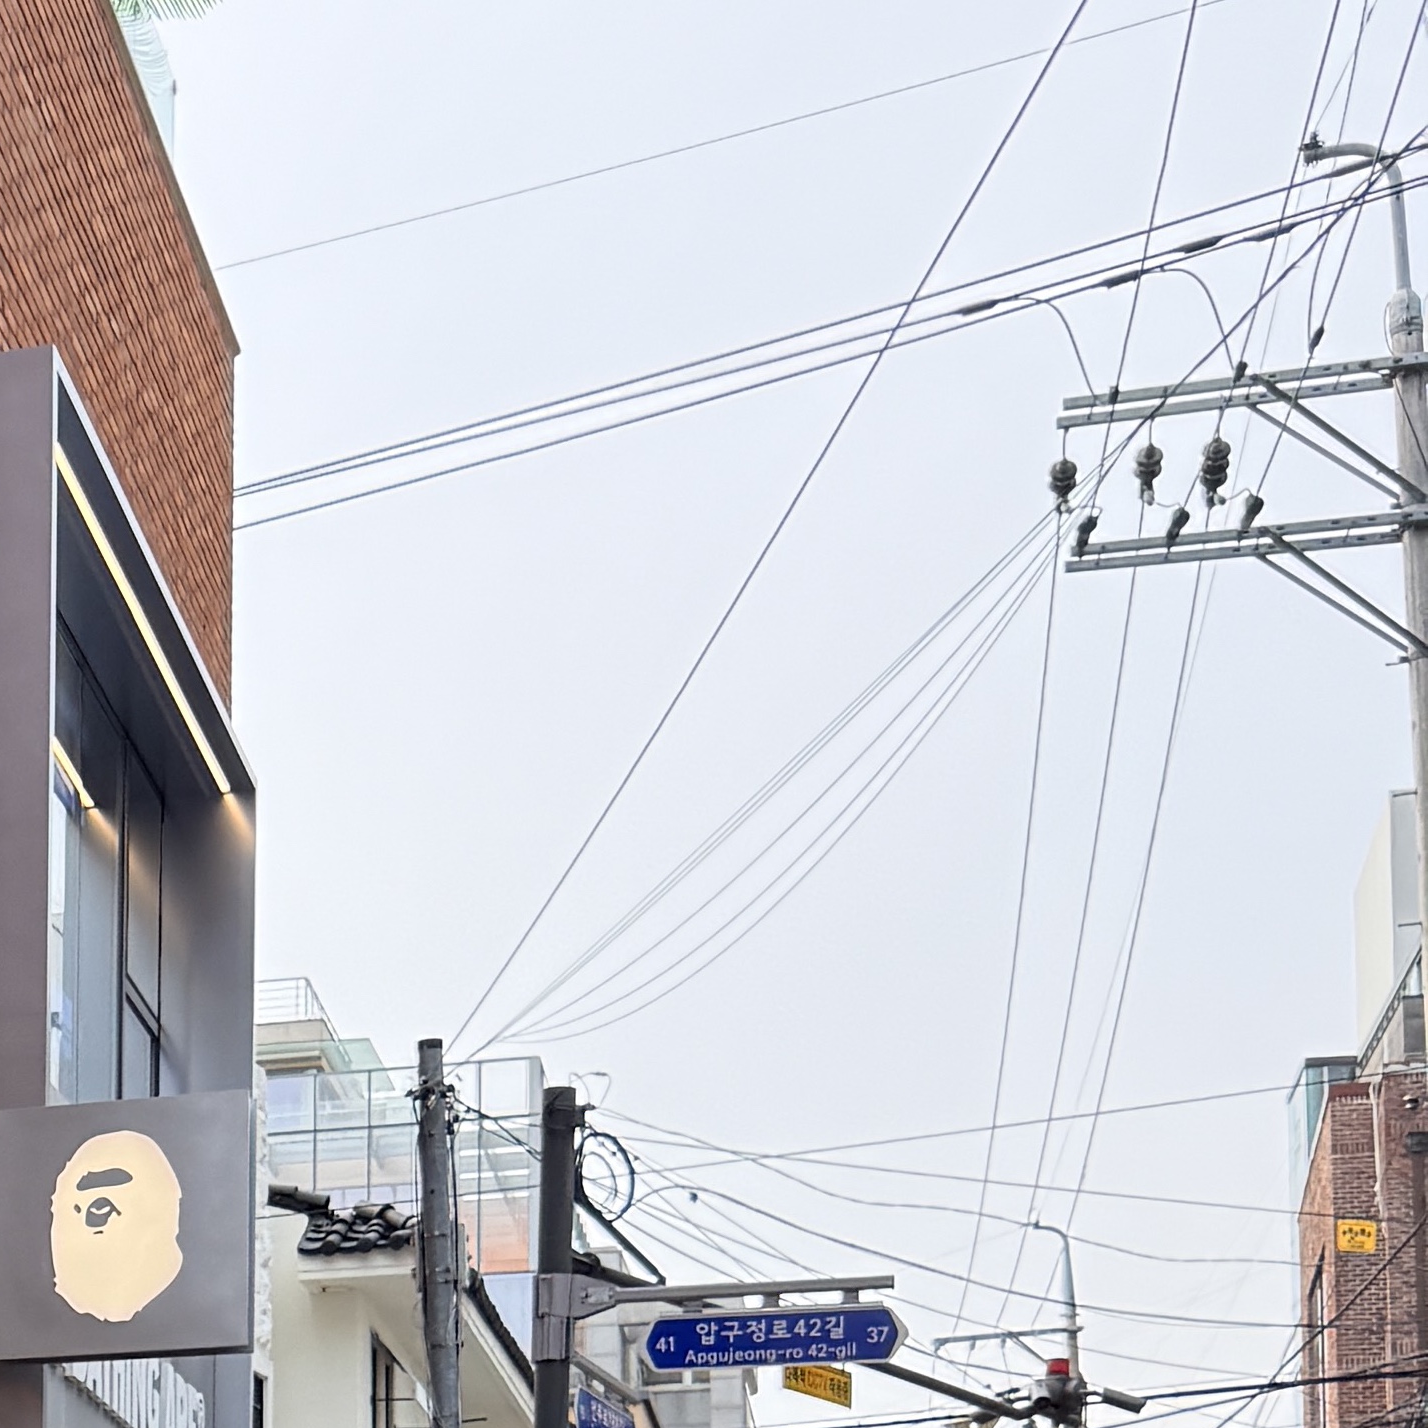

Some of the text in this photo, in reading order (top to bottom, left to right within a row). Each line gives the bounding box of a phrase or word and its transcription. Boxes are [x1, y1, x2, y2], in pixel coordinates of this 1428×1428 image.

[696, 1315, 845, 1345] 압구정로42길
[866, 1326, 890, 1344] 37
[654, 1336, 676, 1353] 41
[685, 1342, 857, 1366] Apgujeong-ro 42-gil
